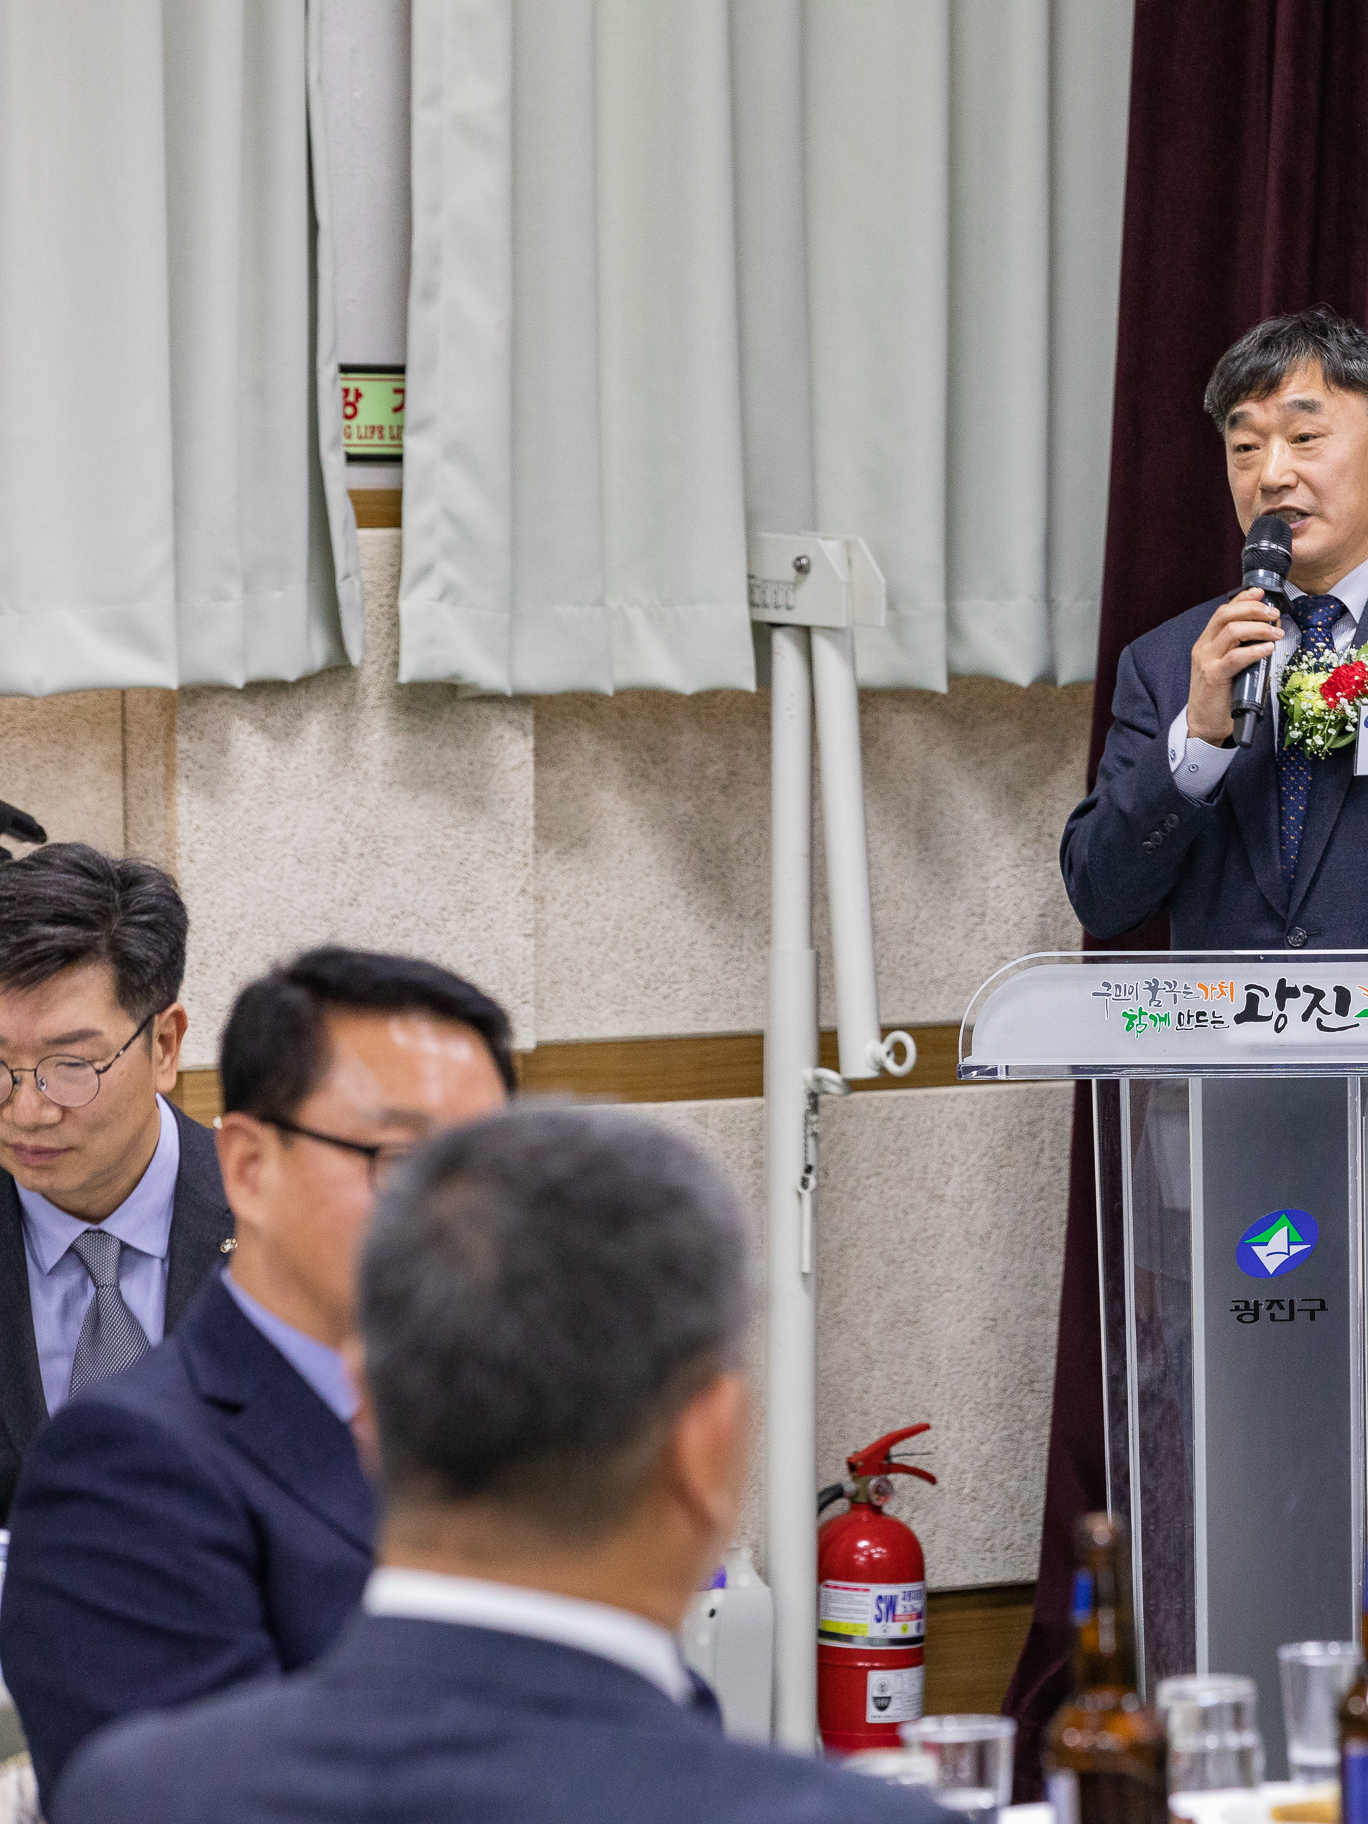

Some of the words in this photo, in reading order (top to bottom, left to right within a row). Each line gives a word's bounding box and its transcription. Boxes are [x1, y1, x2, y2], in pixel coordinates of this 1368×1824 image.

[1091, 980, 1139, 1020] 구민이
[1142, 977, 1201, 1008] 꿈꾸는
[1197, 981, 1235, 1003] 가치
[1233, 977, 1360, 1034] 광진
[1121, 1006, 1172, 1039] 함께
[1175, 1008, 1231, 1031] 만드는
[1229, 1298, 1329, 1325] 광진구
